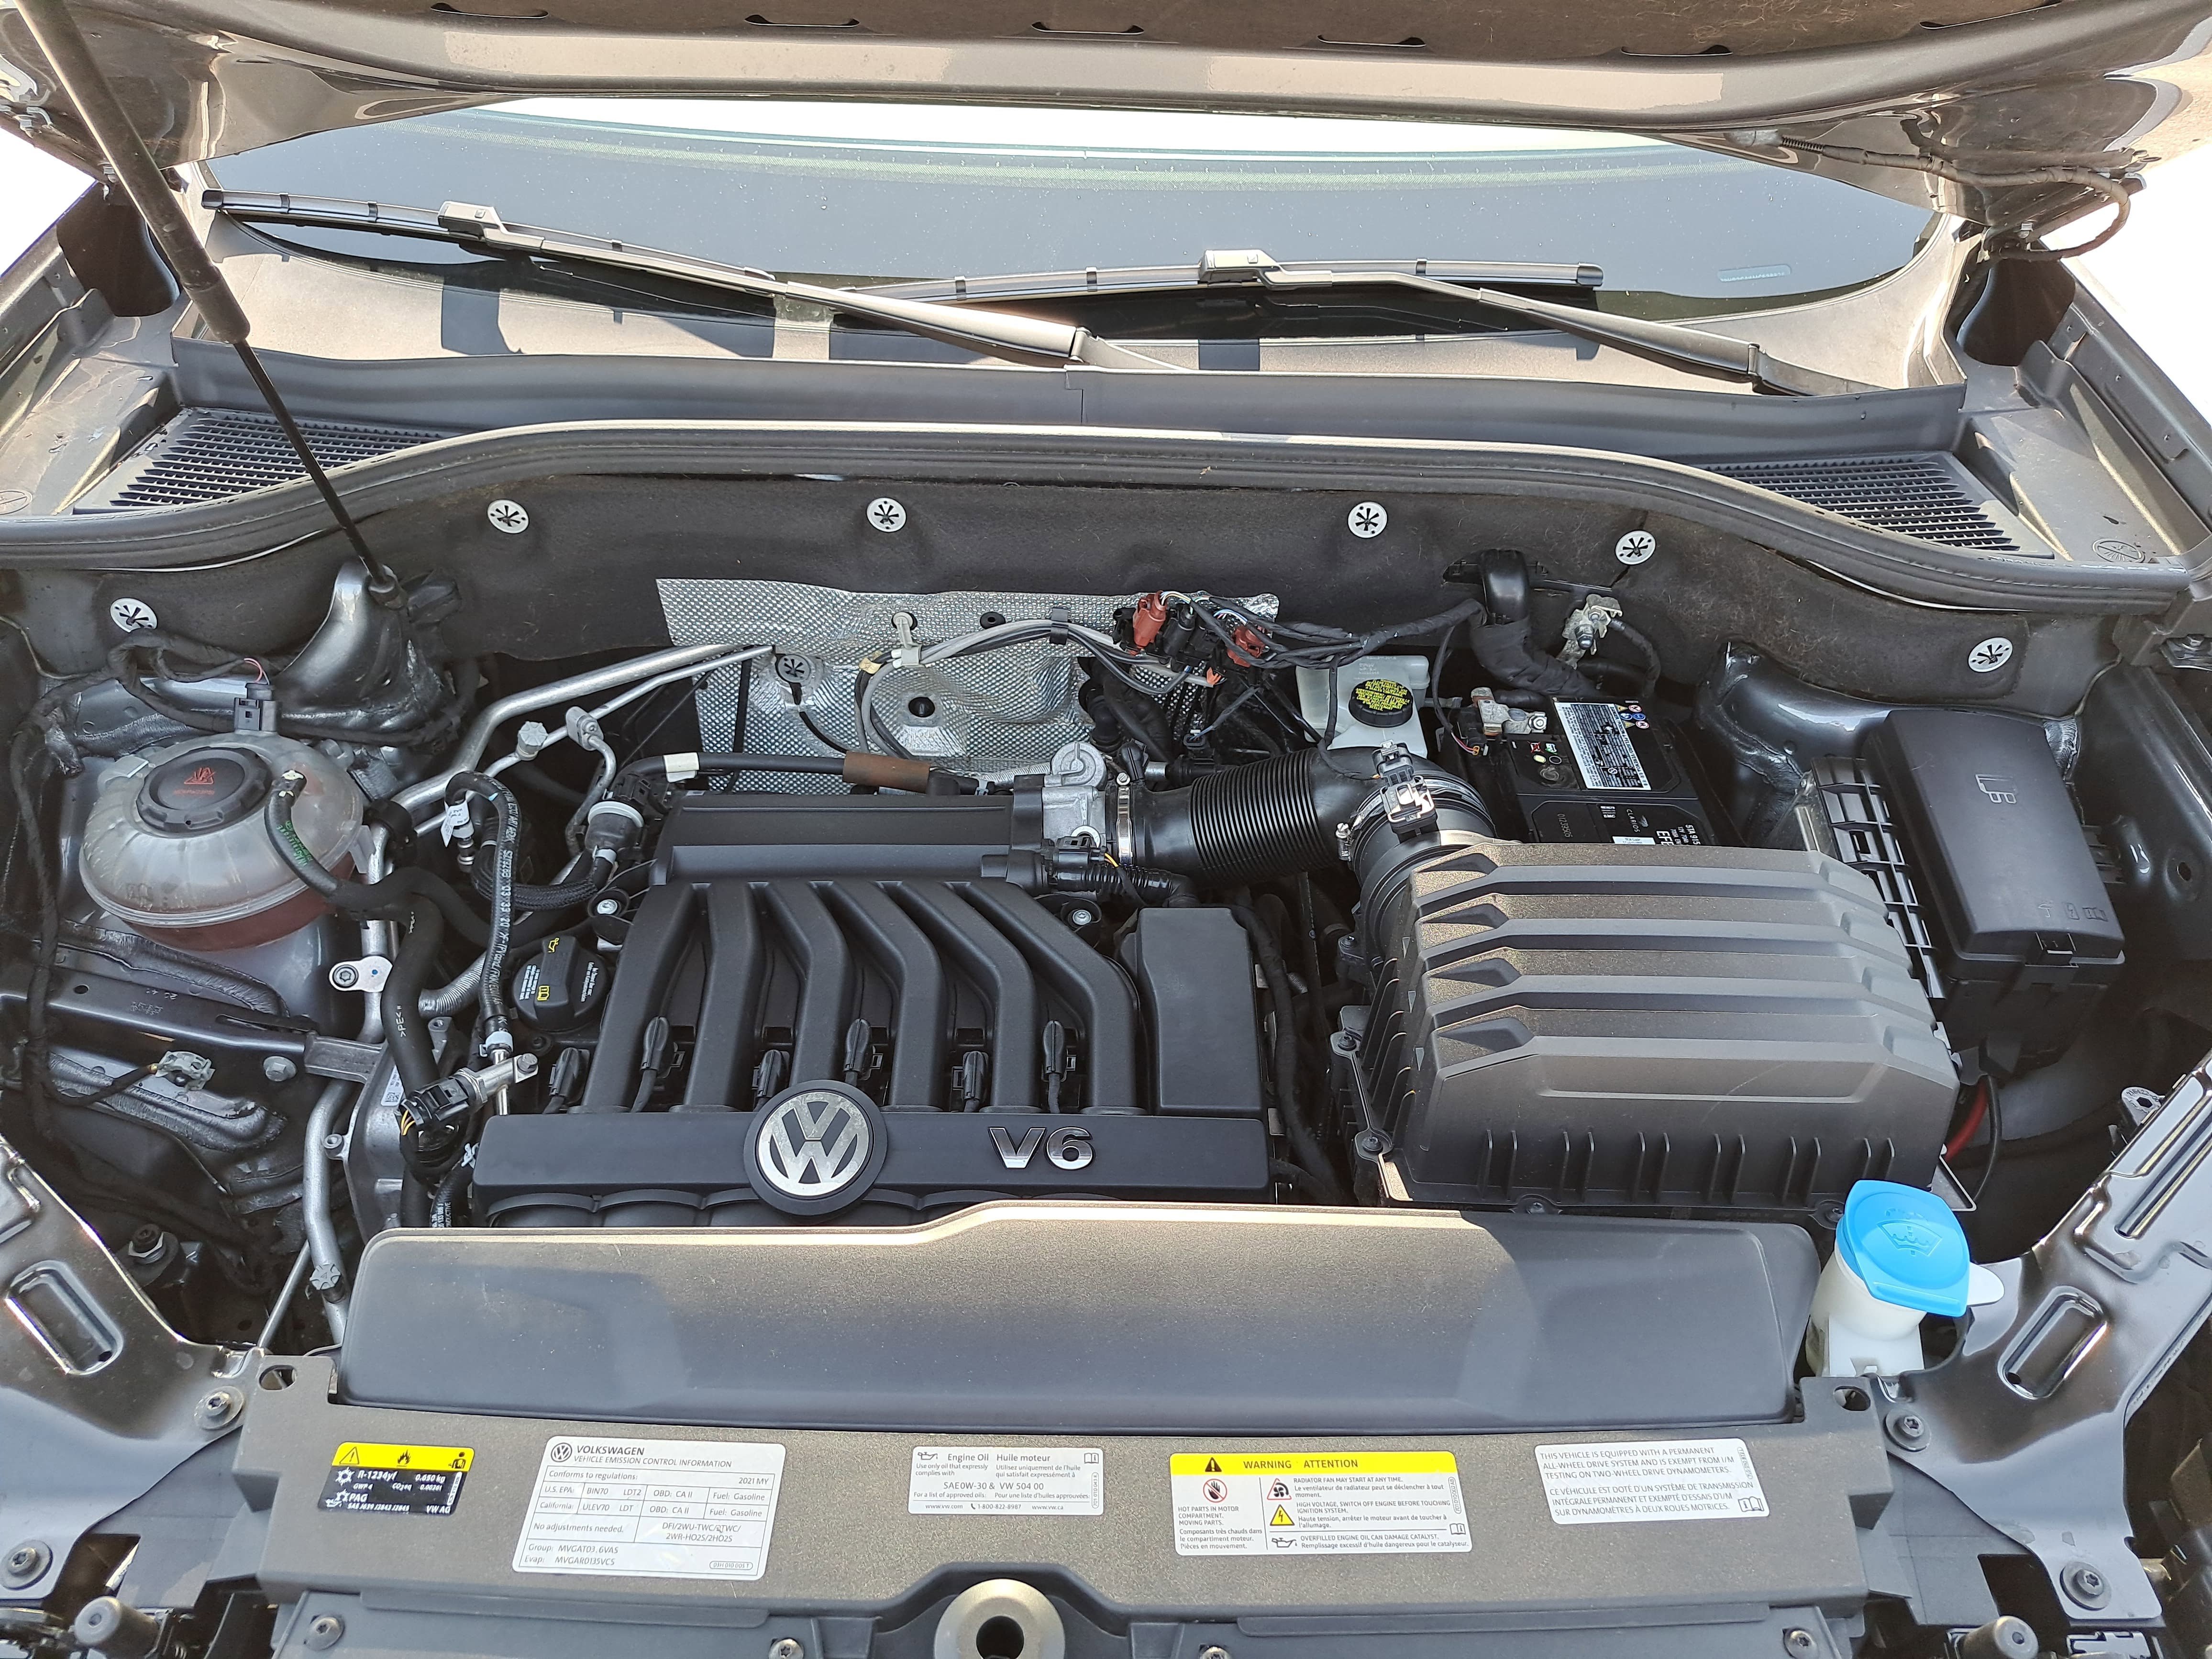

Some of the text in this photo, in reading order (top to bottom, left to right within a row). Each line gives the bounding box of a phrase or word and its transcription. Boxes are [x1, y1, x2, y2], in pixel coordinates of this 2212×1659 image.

[1626, 808, 1640, 833] CLARIOS
[1685, 824, 1701, 845] 5TA 915
[502, 918, 511, 930] 20
[988, 1127, 1094, 1171] V6
[576, 1445, 645, 1456] VOLKSWAGEN
[1539, 1452, 1558, 1460] THIS
[1558, 1451, 1591, 1459] VEHICLE
[1599, 1449, 1638, 1459] EQUIPPED
[1668, 1447, 1714, 1455] PERMANENT
[574, 1455, 732, 1468] VEHICLE EMISSION CONTROL INFORMATION
[947, 1453, 989, 1463] Engine Oil
[996, 1453, 1018, 1461] Huile
[1242, 1460, 1292, 1469] WARNING
[1303, 1459, 1358, 1469] ATTENTION
[1543, 1461, 1586, 1470] ALL-WHEEL
[1585, 1460, 1610, 1468] DRIVE
[1610, 1459, 1639, 1467] SYSTEM
[1667, 1457, 1696, 1465] EXEMPT
[356, 1470, 398, 1482] R-1234yf
[548, 1470, 584, 1478] Conforms
[594, 1471, 638, 1480] regulations:
[1544, 1471, 1577, 1480] TESTING
[1591, 1469, 1642, 1478] TWO-WHEEL
[1641, 1468, 1666, 1476] DRIVE
[1666, 1465, 1731, 1475] DYNAMOMETERS.
[414, 1473, 446, 1483] 0.650 kg
[738, 1476, 755, 1484] 2021
[586, 1487, 608, 1495] BIN70
[988, 1482, 995, 1490] &
[1016, 1482, 1031, 1490] 504
[1033, 1482, 1044, 1490] 00
[1549, 1488, 1560, 1496] CE
[1559, 1486, 1598, 1495] VÉHICULE
[1612, 1484, 1633, 1493] DOTÉ
[1633, 1484, 1654, 1493] D'UN
[1653, 1482, 1687, 1492] SYSTÈME
[1686, 1482, 1698, 1491] DE
[1697, 1481, 1754, 1490] TRANSMISSION
[623, 1488, 641, 1496] LDT2
[675, 1490, 686, 1498] CA
[712, 1492, 765, 1501] Fuel: Gasoline
[348, 1493, 368, 1502] PAG
[1551, 1497, 1593, 1506] INTÉGRALE
[1592, 1495, 1637, 1504] PERMANENT
[1648, 1492, 1681, 1502] EXEMPTÉ
[1681, 1493, 1713, 1501] D'ESSAIS
[426, 1504, 451, 1514] VW AG
[539, 1501, 574, 1509] California:
[582, 1503, 610, 1511] ULEV70
[619, 1504, 634, 1512] LDT
[649, 1505, 669, 1514] OBD:
[672, 1506, 682, 1514] CA
[1554, 1508, 1571, 1516] SUR
[1571, 1505, 1634, 1515] DYNAMOMÈTRES
[1641, 1504, 1664, 1513] DEUX
[1663, 1504, 1690, 1512] ROUES
[1690, 1502, 1730, 1511] MOTRICES.
[709, 1507, 762, 1517] Fuel: Gasoline
[545, 1522, 593, 1532] adjustments
[594, 1524, 624, 1533] needed.
[528, 1543, 553, 1553] Group:
